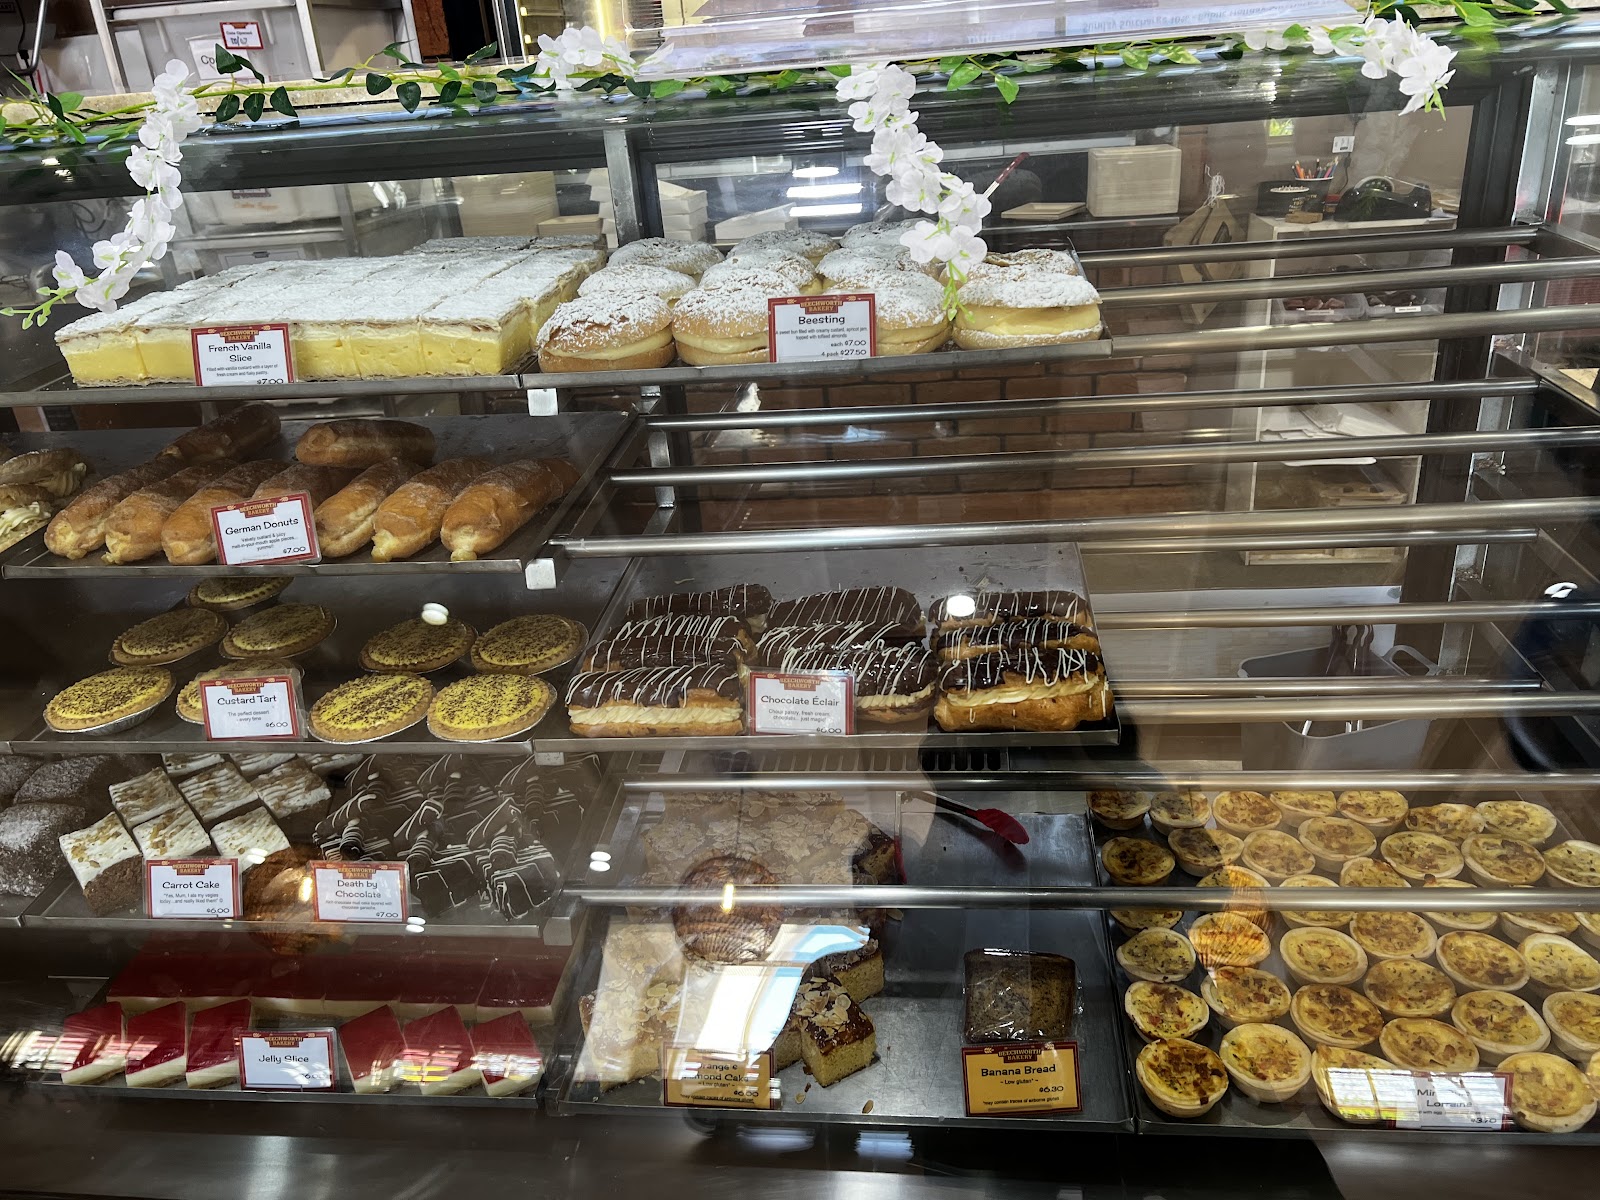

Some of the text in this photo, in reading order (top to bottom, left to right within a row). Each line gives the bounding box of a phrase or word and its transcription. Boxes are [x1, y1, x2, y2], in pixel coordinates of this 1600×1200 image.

[798, 315, 845, 325] Beesting
[208, 342, 272, 352] French Vanilla
[229, 354, 252, 362] Slice
[239, 502, 276, 512] BEECHWORTH
[225, 518, 299, 535] German Donuts
[283, 546, 306, 554] $7.00
[217, 695, 277, 705] Custard Tart
[761, 695, 840, 706] Chocolate Éclair
[816, 726, 842, 734] $6.00
[162, 881, 220, 889] Carrot Cake
[337, 879, 378, 889] Death by
[335, 890, 381, 898] Chocolate
[258, 1055, 309, 1065] Jelly Slice
[981, 1064, 1056, 1077] Banana Bread
[725, 1073, 749, 1082] Cake
